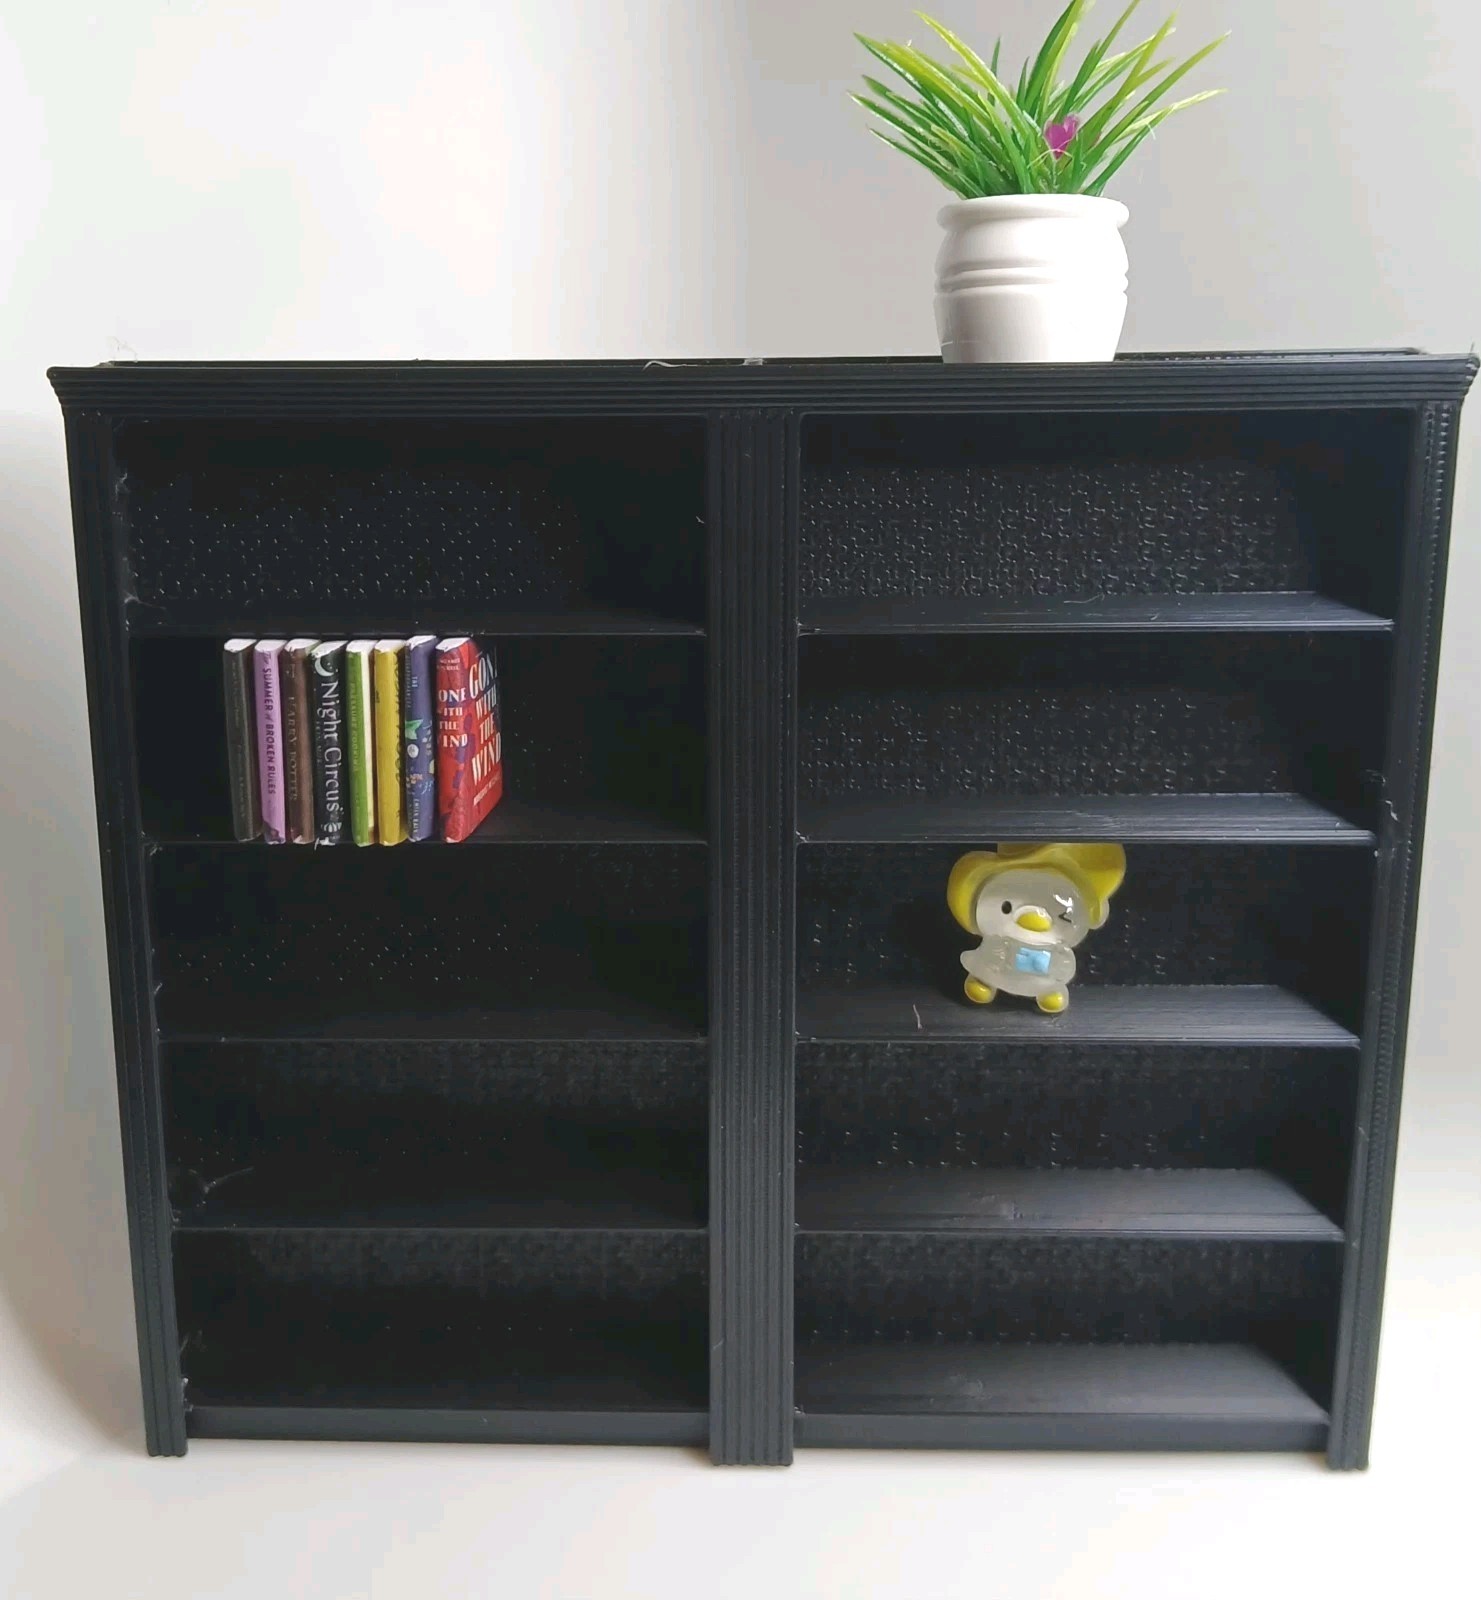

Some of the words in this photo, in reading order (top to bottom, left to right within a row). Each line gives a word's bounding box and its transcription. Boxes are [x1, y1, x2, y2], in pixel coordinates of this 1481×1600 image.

[263, 667, 274, 711] SUMMER
[438, 687, 466, 702] ONE
[476, 683, 498, 721] WITH
[316, 680, 342, 740] Night
[438, 707, 463, 717] ITH
[479, 711, 495, 745] THE
[266, 724, 276, 763] BROKEN
[442, 733, 468, 748] IND
[471, 731, 502, 787] WIND
[267, 766, 277, 794] RULES
[324, 747, 342, 812] Circus
